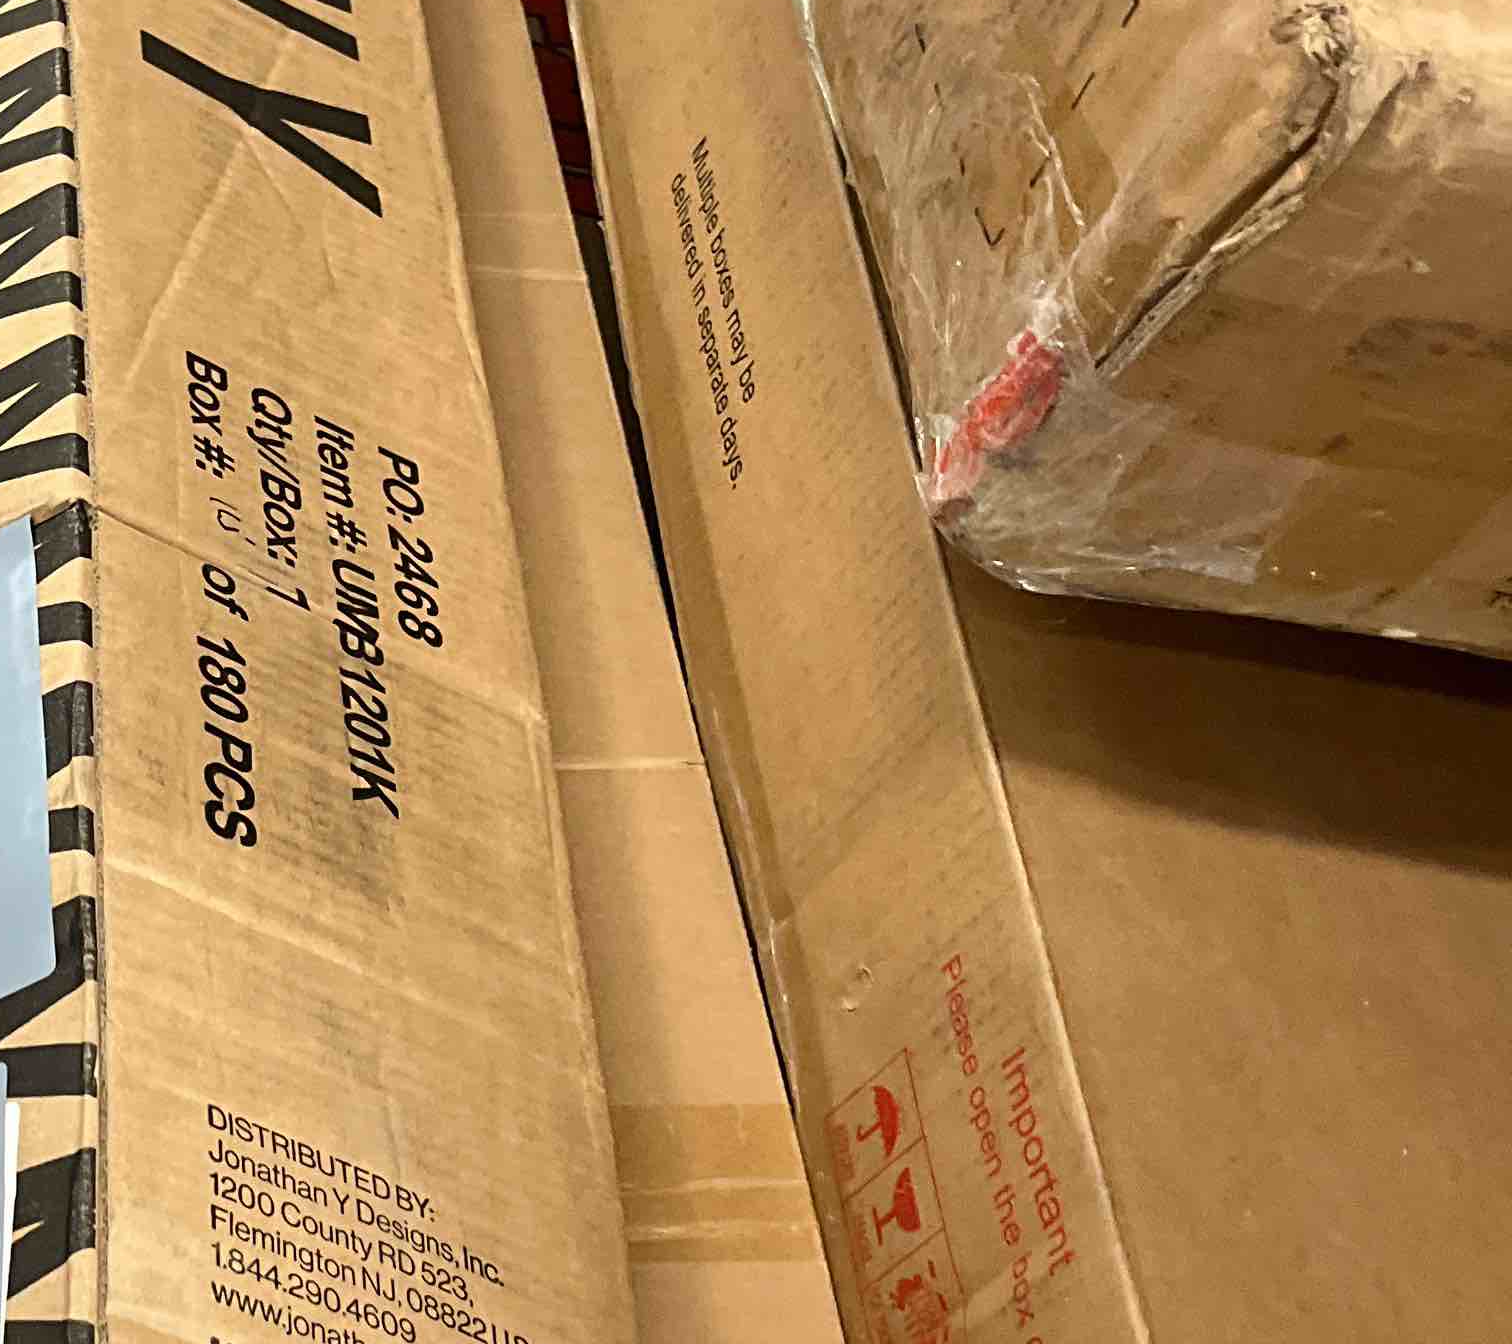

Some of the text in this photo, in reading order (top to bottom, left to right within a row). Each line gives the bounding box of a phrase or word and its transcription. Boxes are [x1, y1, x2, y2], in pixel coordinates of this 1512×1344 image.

[140, 30, 383, 217] Y
[671, 173, 742, 490] delivered in separate days.
[692, 136, 755, 403] Multiple boxes may be
[186, 350, 228, 435] Box
[193, 434, 236, 480] #:
[247, 387, 312, 612] Qty/Box: 1
[378, 446, 444, 648] PO: 2468
[201, 563, 250, 622] of
[314, 416, 400, 820] Item #: UMB1201K
[197, 634, 249, 724] 180
[203, 720, 258, 848] PCS
[208, 1104, 436, 1222] DISTRIBUTED BY:
[209, 1139, 328, 1208] Jonathan
[332, 1188, 350, 1215] Y
[940, 954, 977, 1076] Please
[969, 1086, 1002, 1178] open
[992, 1183, 1020, 1247] the
[1010, 1256, 1035, 1329] box
[1001, 1046, 1076, 1277] Important
[209, 1172, 474, 1306] 1200 County RD 523,
[210, 1204, 356, 1287] Flemington
[362, 1267, 402, 1308] NJ,
[406, 1286, 488, 1343] 08822
[212, 1242, 417, 1344] 1.844.290.4609
